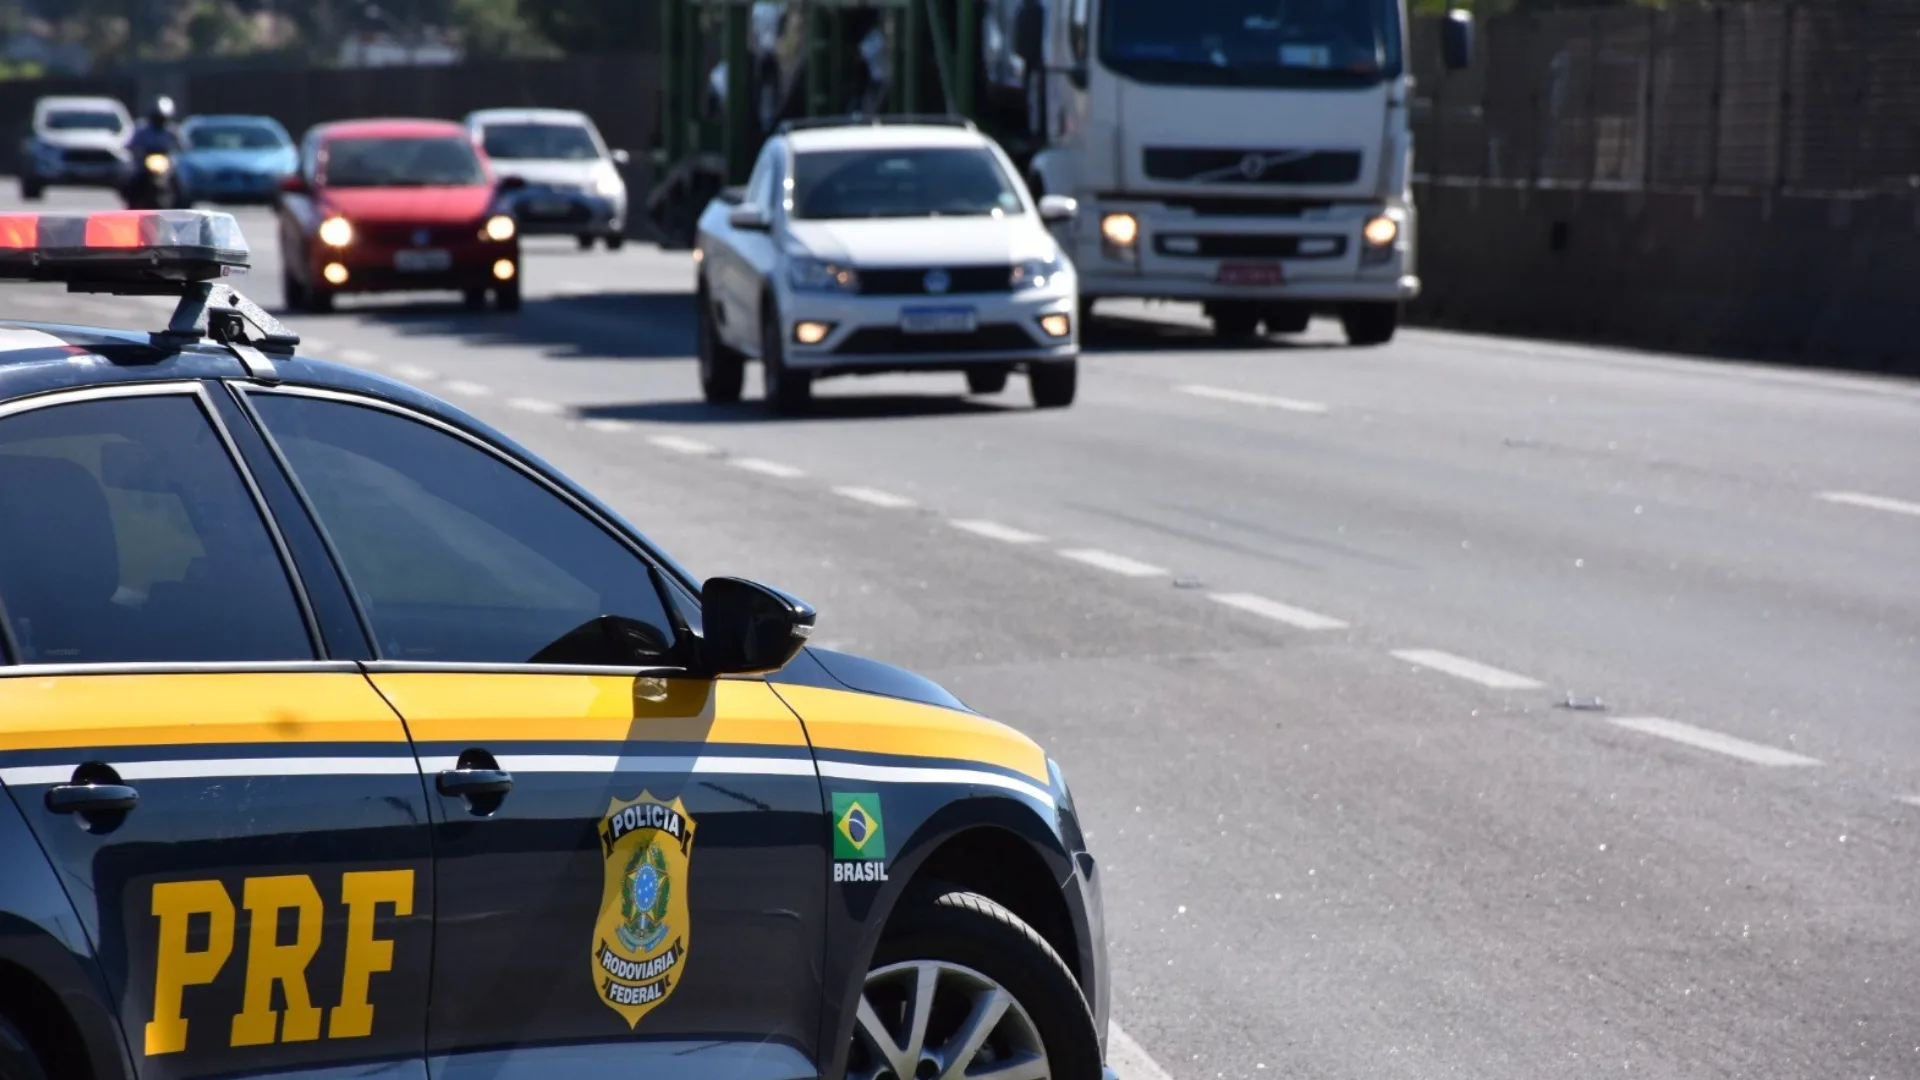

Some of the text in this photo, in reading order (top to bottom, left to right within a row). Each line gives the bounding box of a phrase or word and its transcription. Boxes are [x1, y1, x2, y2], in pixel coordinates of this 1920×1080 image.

[833, 861, 889, 882] BRASIL
[144, 869, 415, 1056] PRF
[609, 982, 662, 1004] FEDERAL
